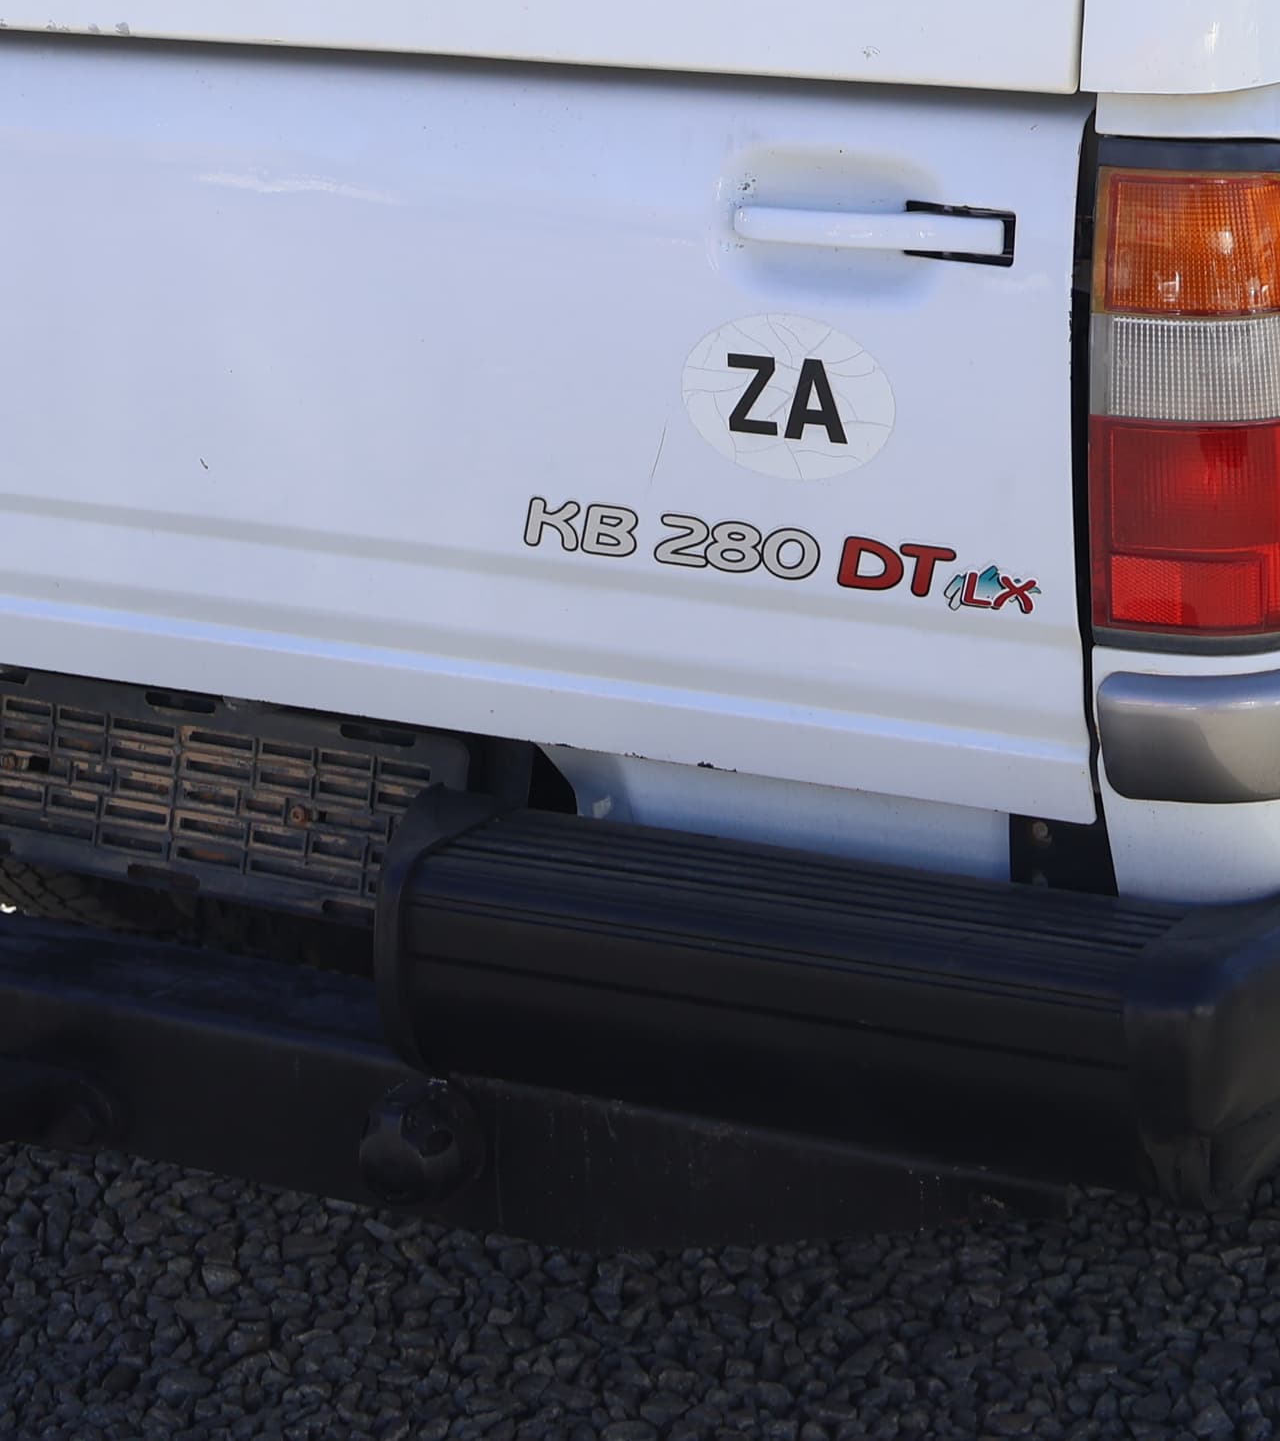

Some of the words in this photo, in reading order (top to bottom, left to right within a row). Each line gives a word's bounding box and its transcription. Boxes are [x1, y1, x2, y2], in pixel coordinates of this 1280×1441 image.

[727, 353, 848, 444] ZA
[523, 497, 638, 557] KB
[654, 513, 820, 580] 280
[837, 536, 957, 597] DT
